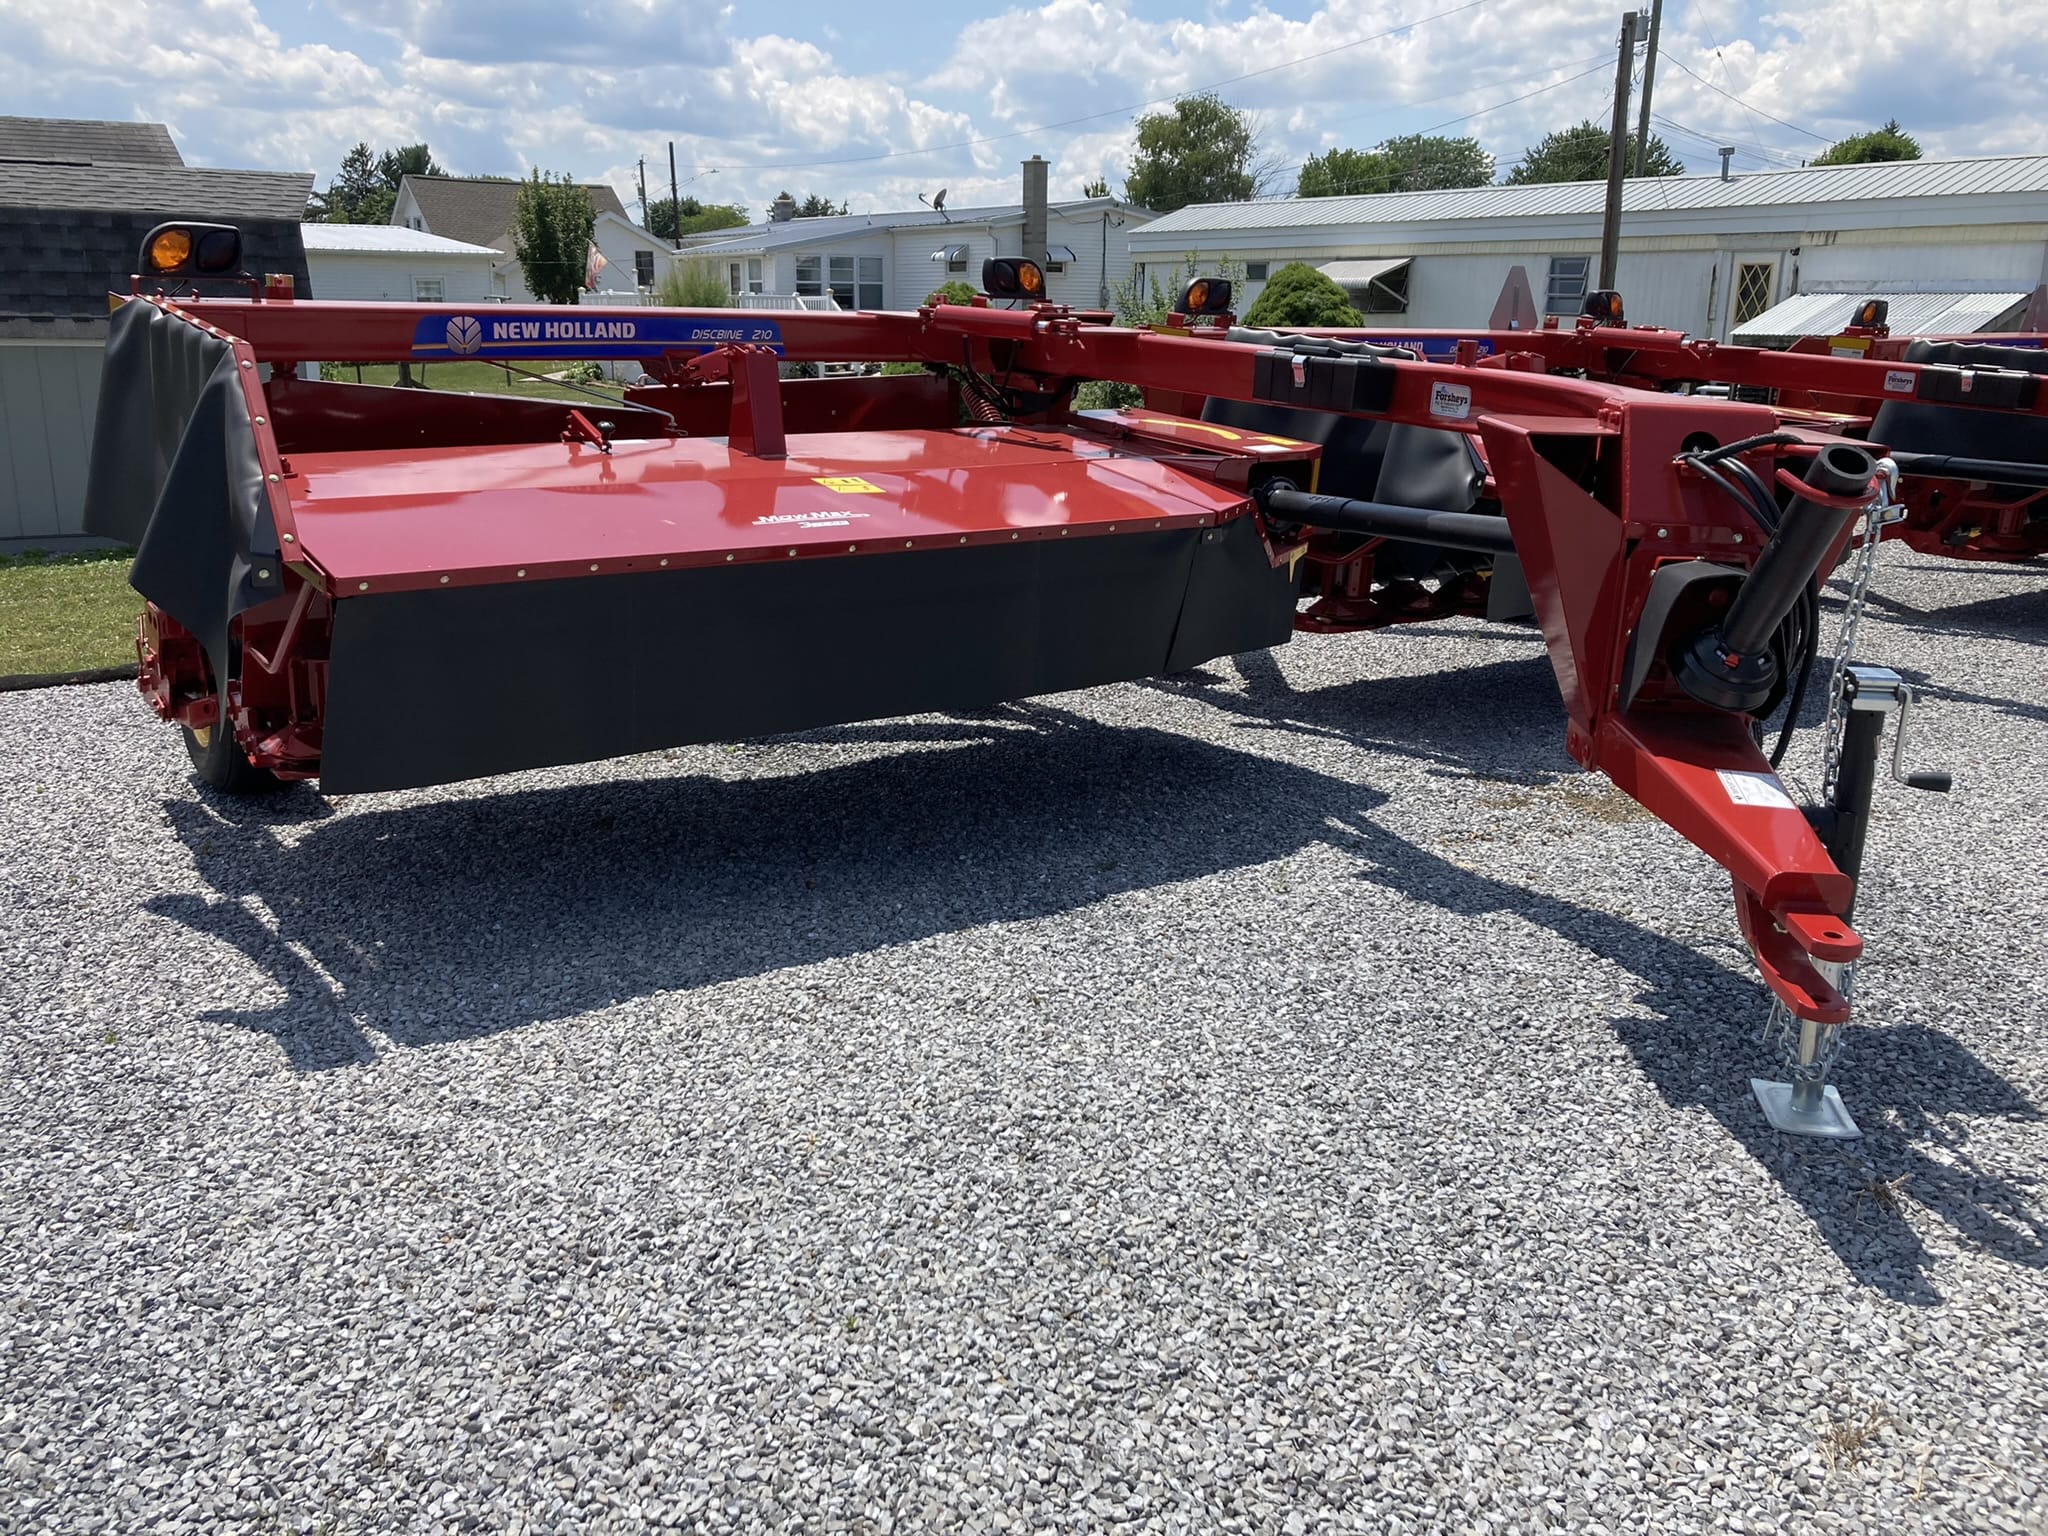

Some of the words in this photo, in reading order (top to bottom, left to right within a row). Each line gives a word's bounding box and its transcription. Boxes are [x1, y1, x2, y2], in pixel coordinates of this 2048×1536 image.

[493, 322, 540, 339] NEW
[545, 322, 636, 340] HOLLAND
[691, 328, 744, 340] DISCBINE
[751, 329, 773, 341] 210
[1435, 390, 1468, 407] Forsheys
